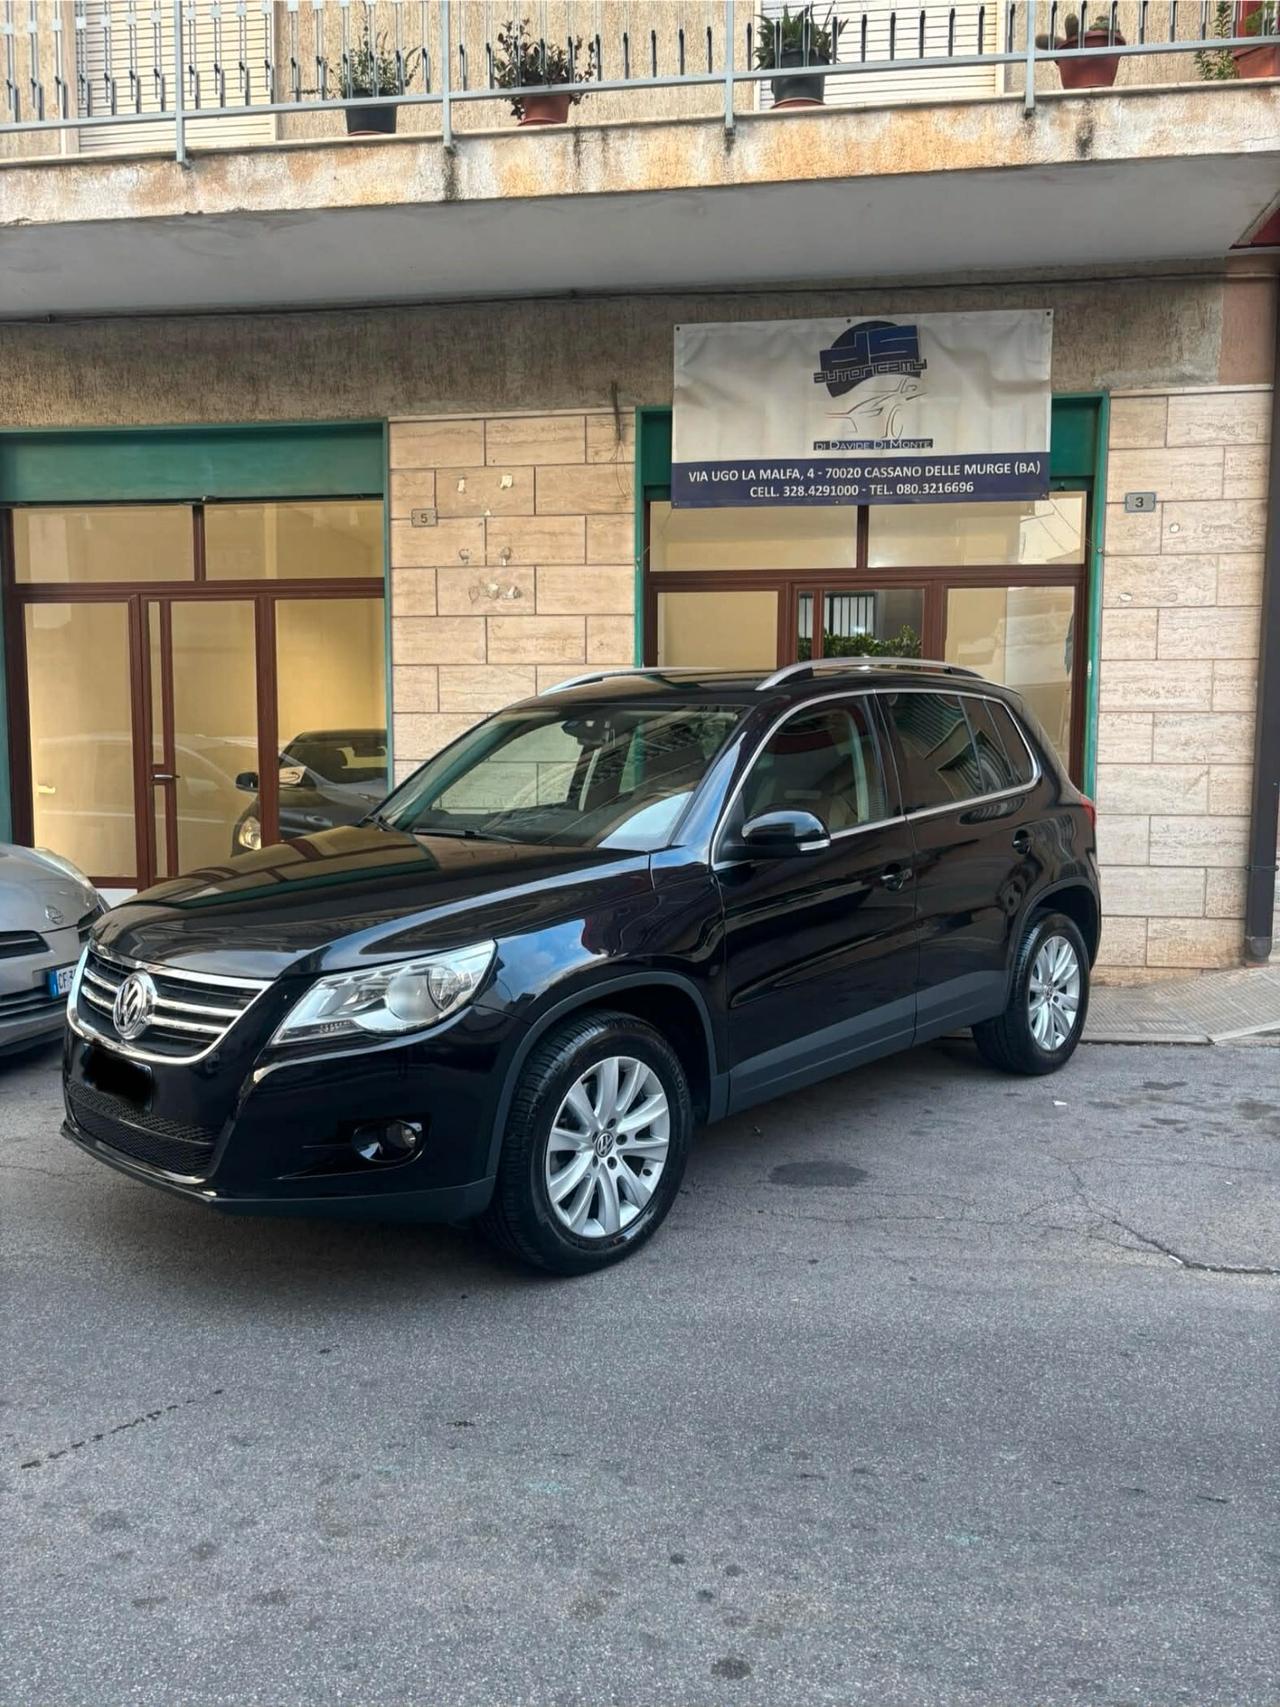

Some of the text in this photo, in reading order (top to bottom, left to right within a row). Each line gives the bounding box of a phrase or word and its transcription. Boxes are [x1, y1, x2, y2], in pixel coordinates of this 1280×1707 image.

[688, 470, 709, 483] VIA
[711, 470, 739, 482] UGO
[741, 469, 756, 480] LA
[759, 468, 804, 482] MALFA,
[806, 467, 815, 479] 4
[825, 466, 862, 479] 70020
[864, 465, 922, 478] CASSANO
[925, 464, 961, 477] DELLE
[964, 462, 1012, 475] MURGE
[1014, 460, 1041, 476] (BA)
[749, 486, 780, 498] CELL.
[783, 485, 859, 498] 328.4291000
[869, 484, 893, 496] TEL.
[896, 481, 975, 495] 080.3216696
[1135, 497, 1144, 508] 3
[420, 513, 428, 523] 5
